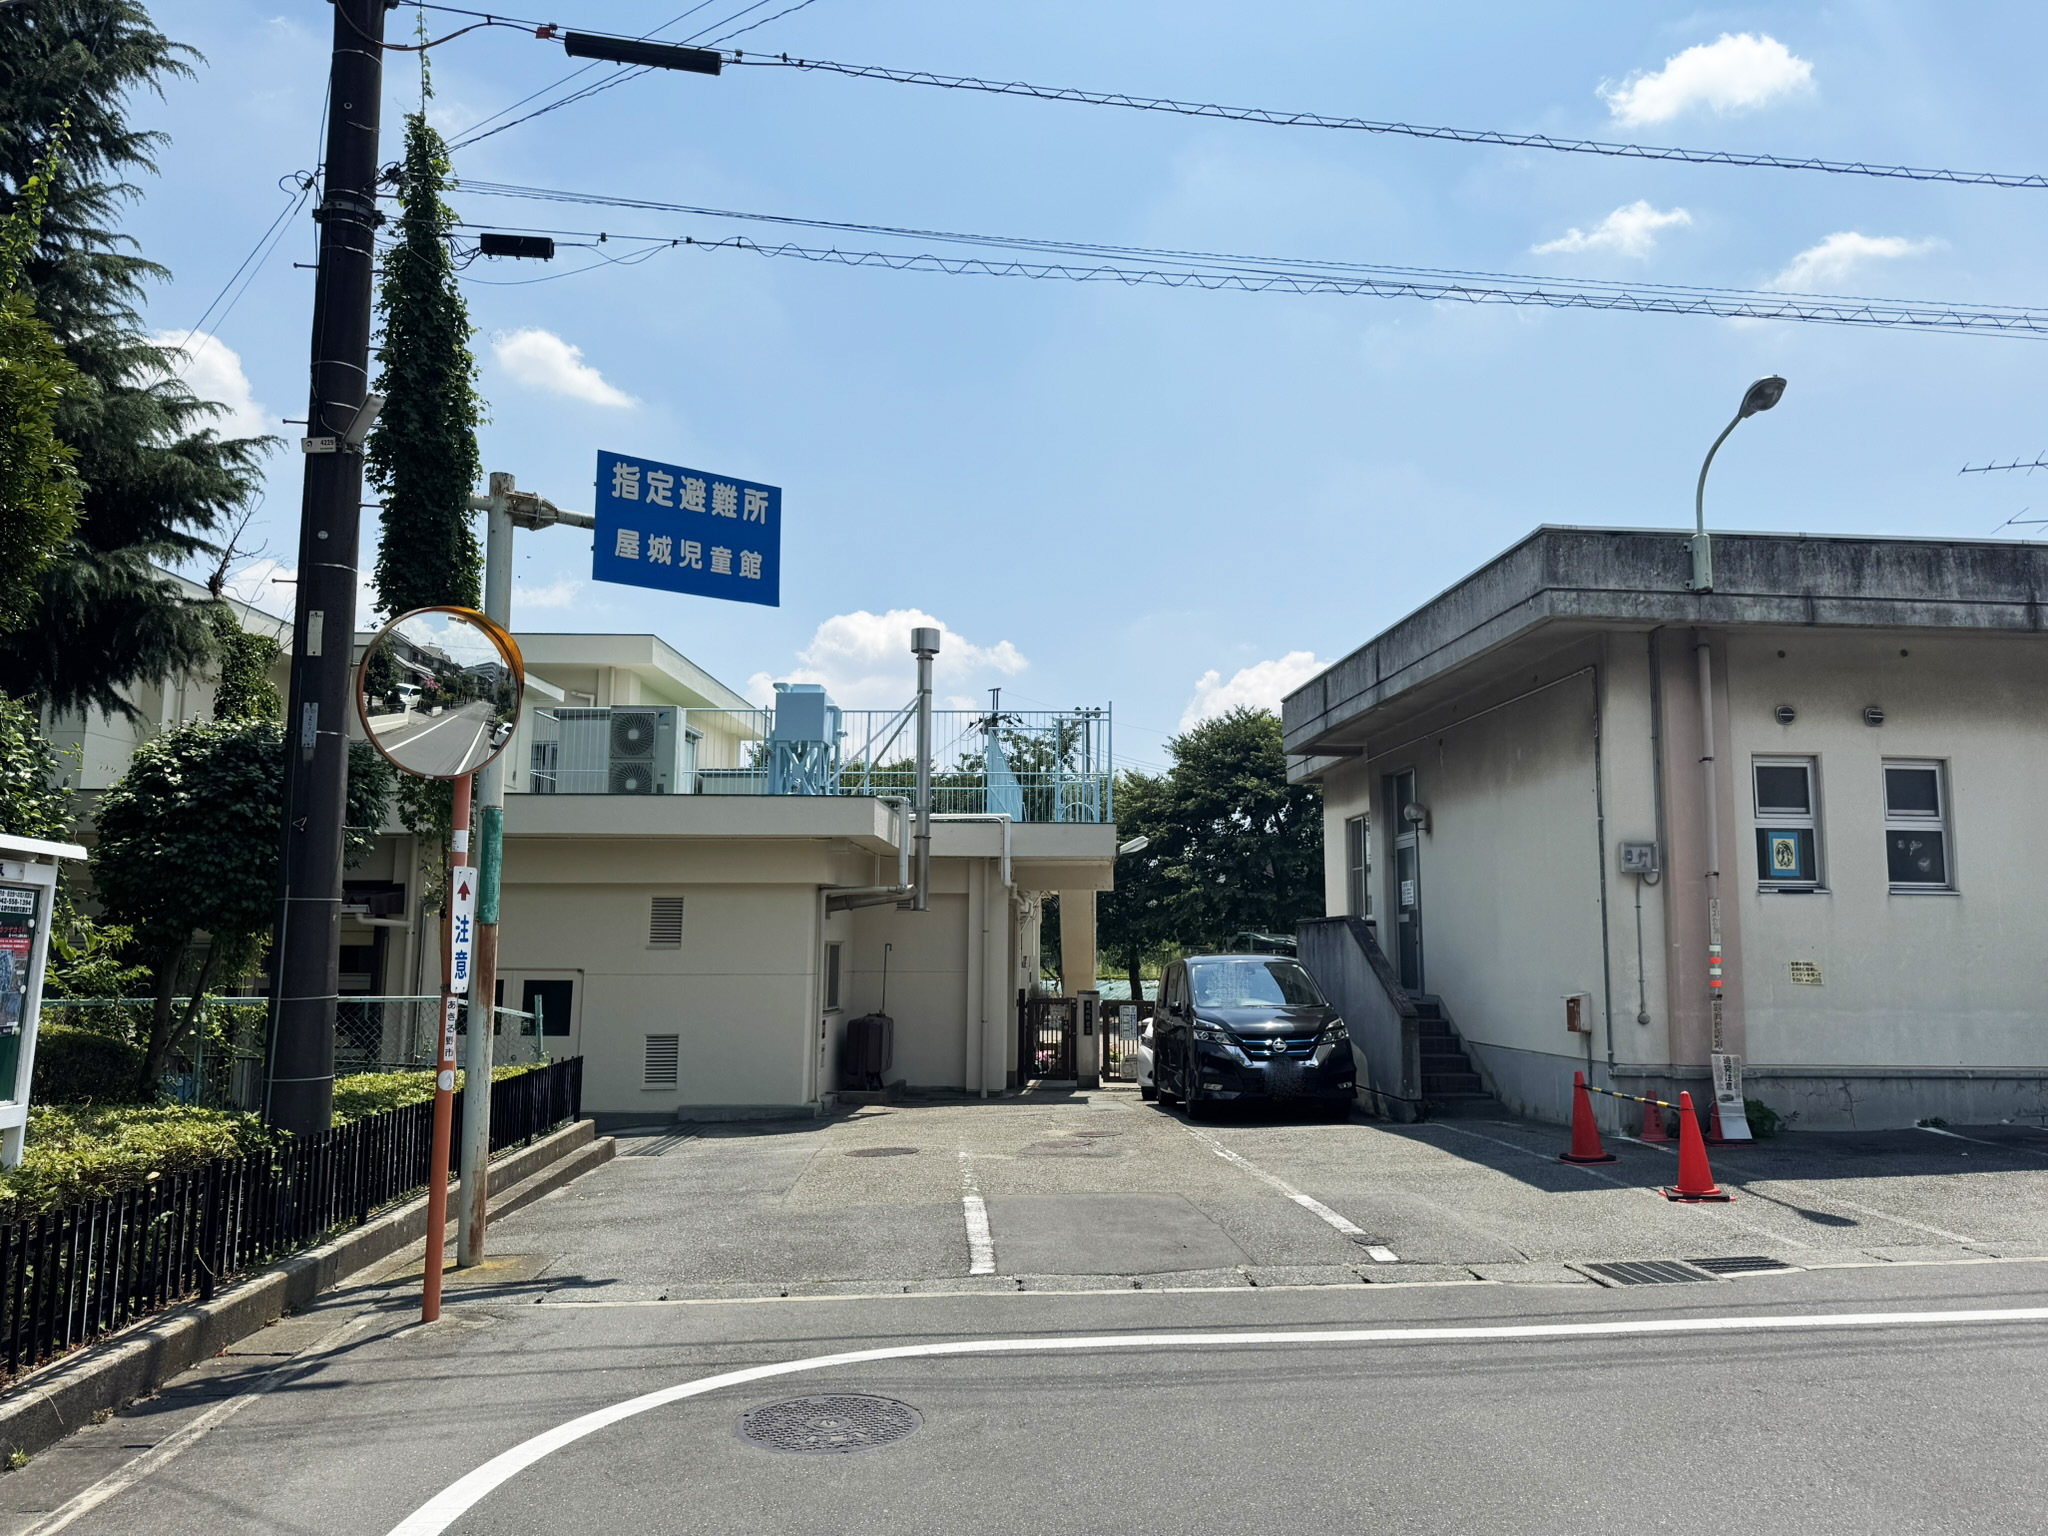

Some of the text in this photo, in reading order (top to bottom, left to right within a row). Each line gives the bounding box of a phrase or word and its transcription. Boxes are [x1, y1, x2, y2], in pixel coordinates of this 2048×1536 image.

[611, 461, 769, 525] 指定避難所
[614, 528, 763, 580] 屋城児童館
[454, 914, 470, 981] 注意
[444, 1000, 456, 1058] あきる野市
